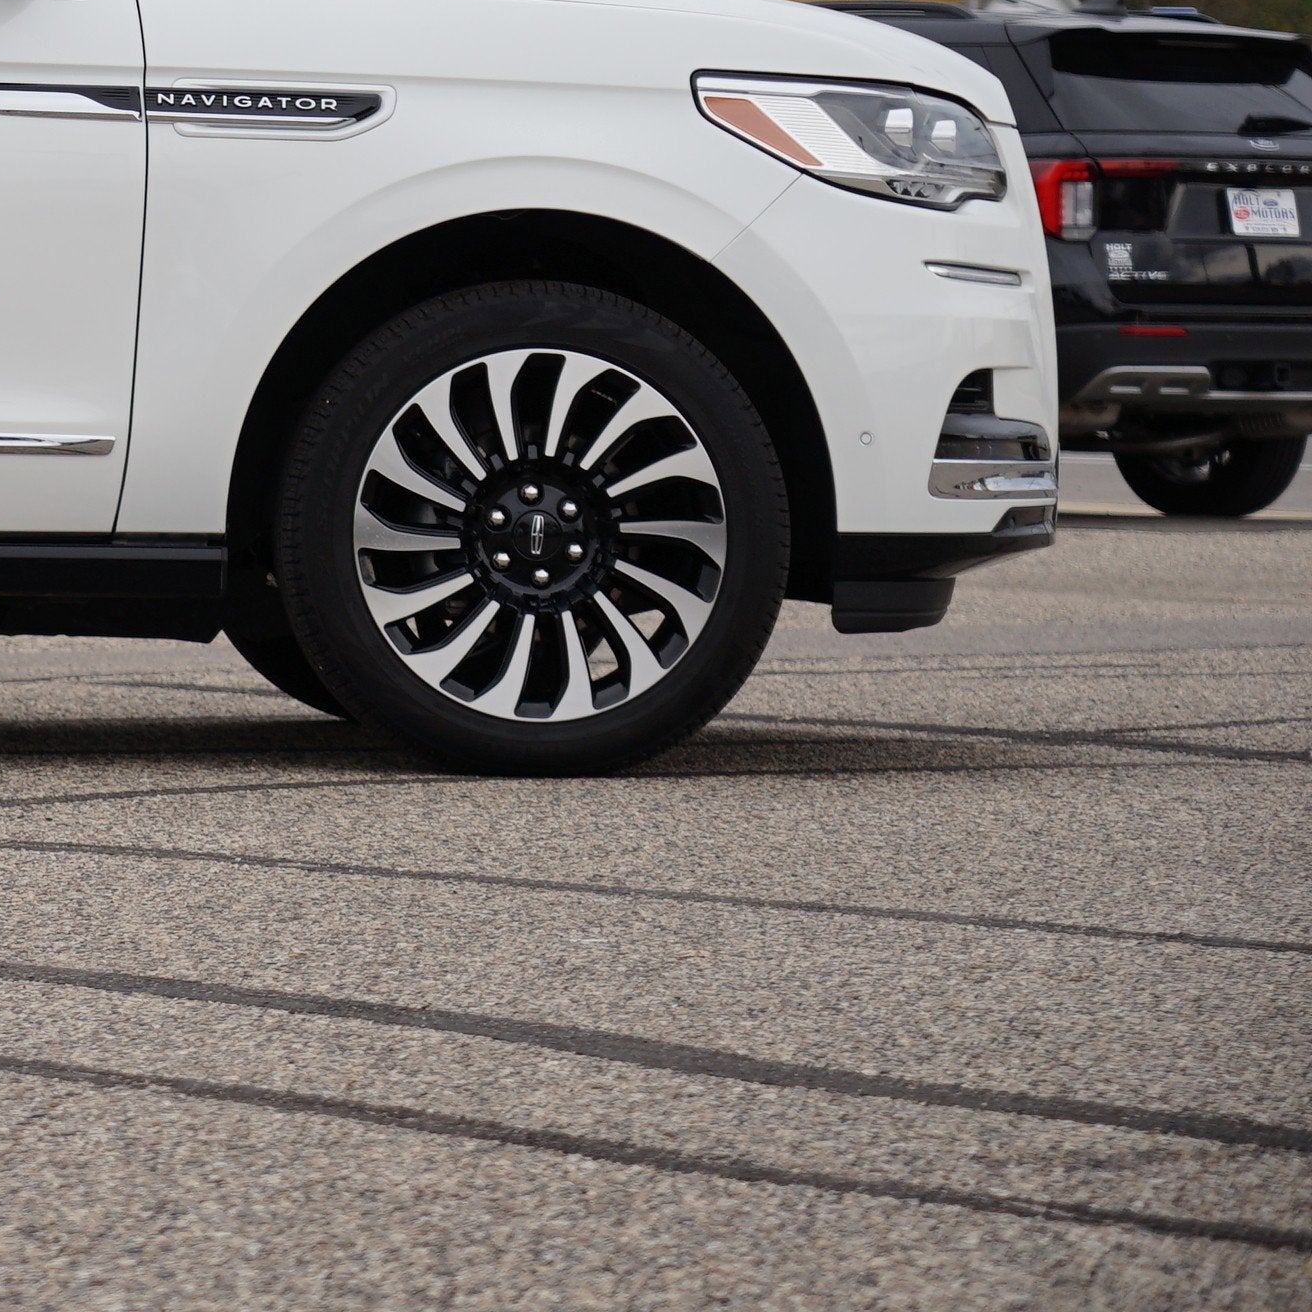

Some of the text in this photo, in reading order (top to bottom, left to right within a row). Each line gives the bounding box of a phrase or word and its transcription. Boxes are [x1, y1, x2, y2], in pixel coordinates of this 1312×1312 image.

[157, 93, 338, 111] NAVIGATOR
[1233, 193, 1260, 206] HOLT
[1251, 206, 1295, 220] MOTORS
[1105, 243, 1132, 251] HOLT
[1108, 270, 1169, 280] ACTIVE
